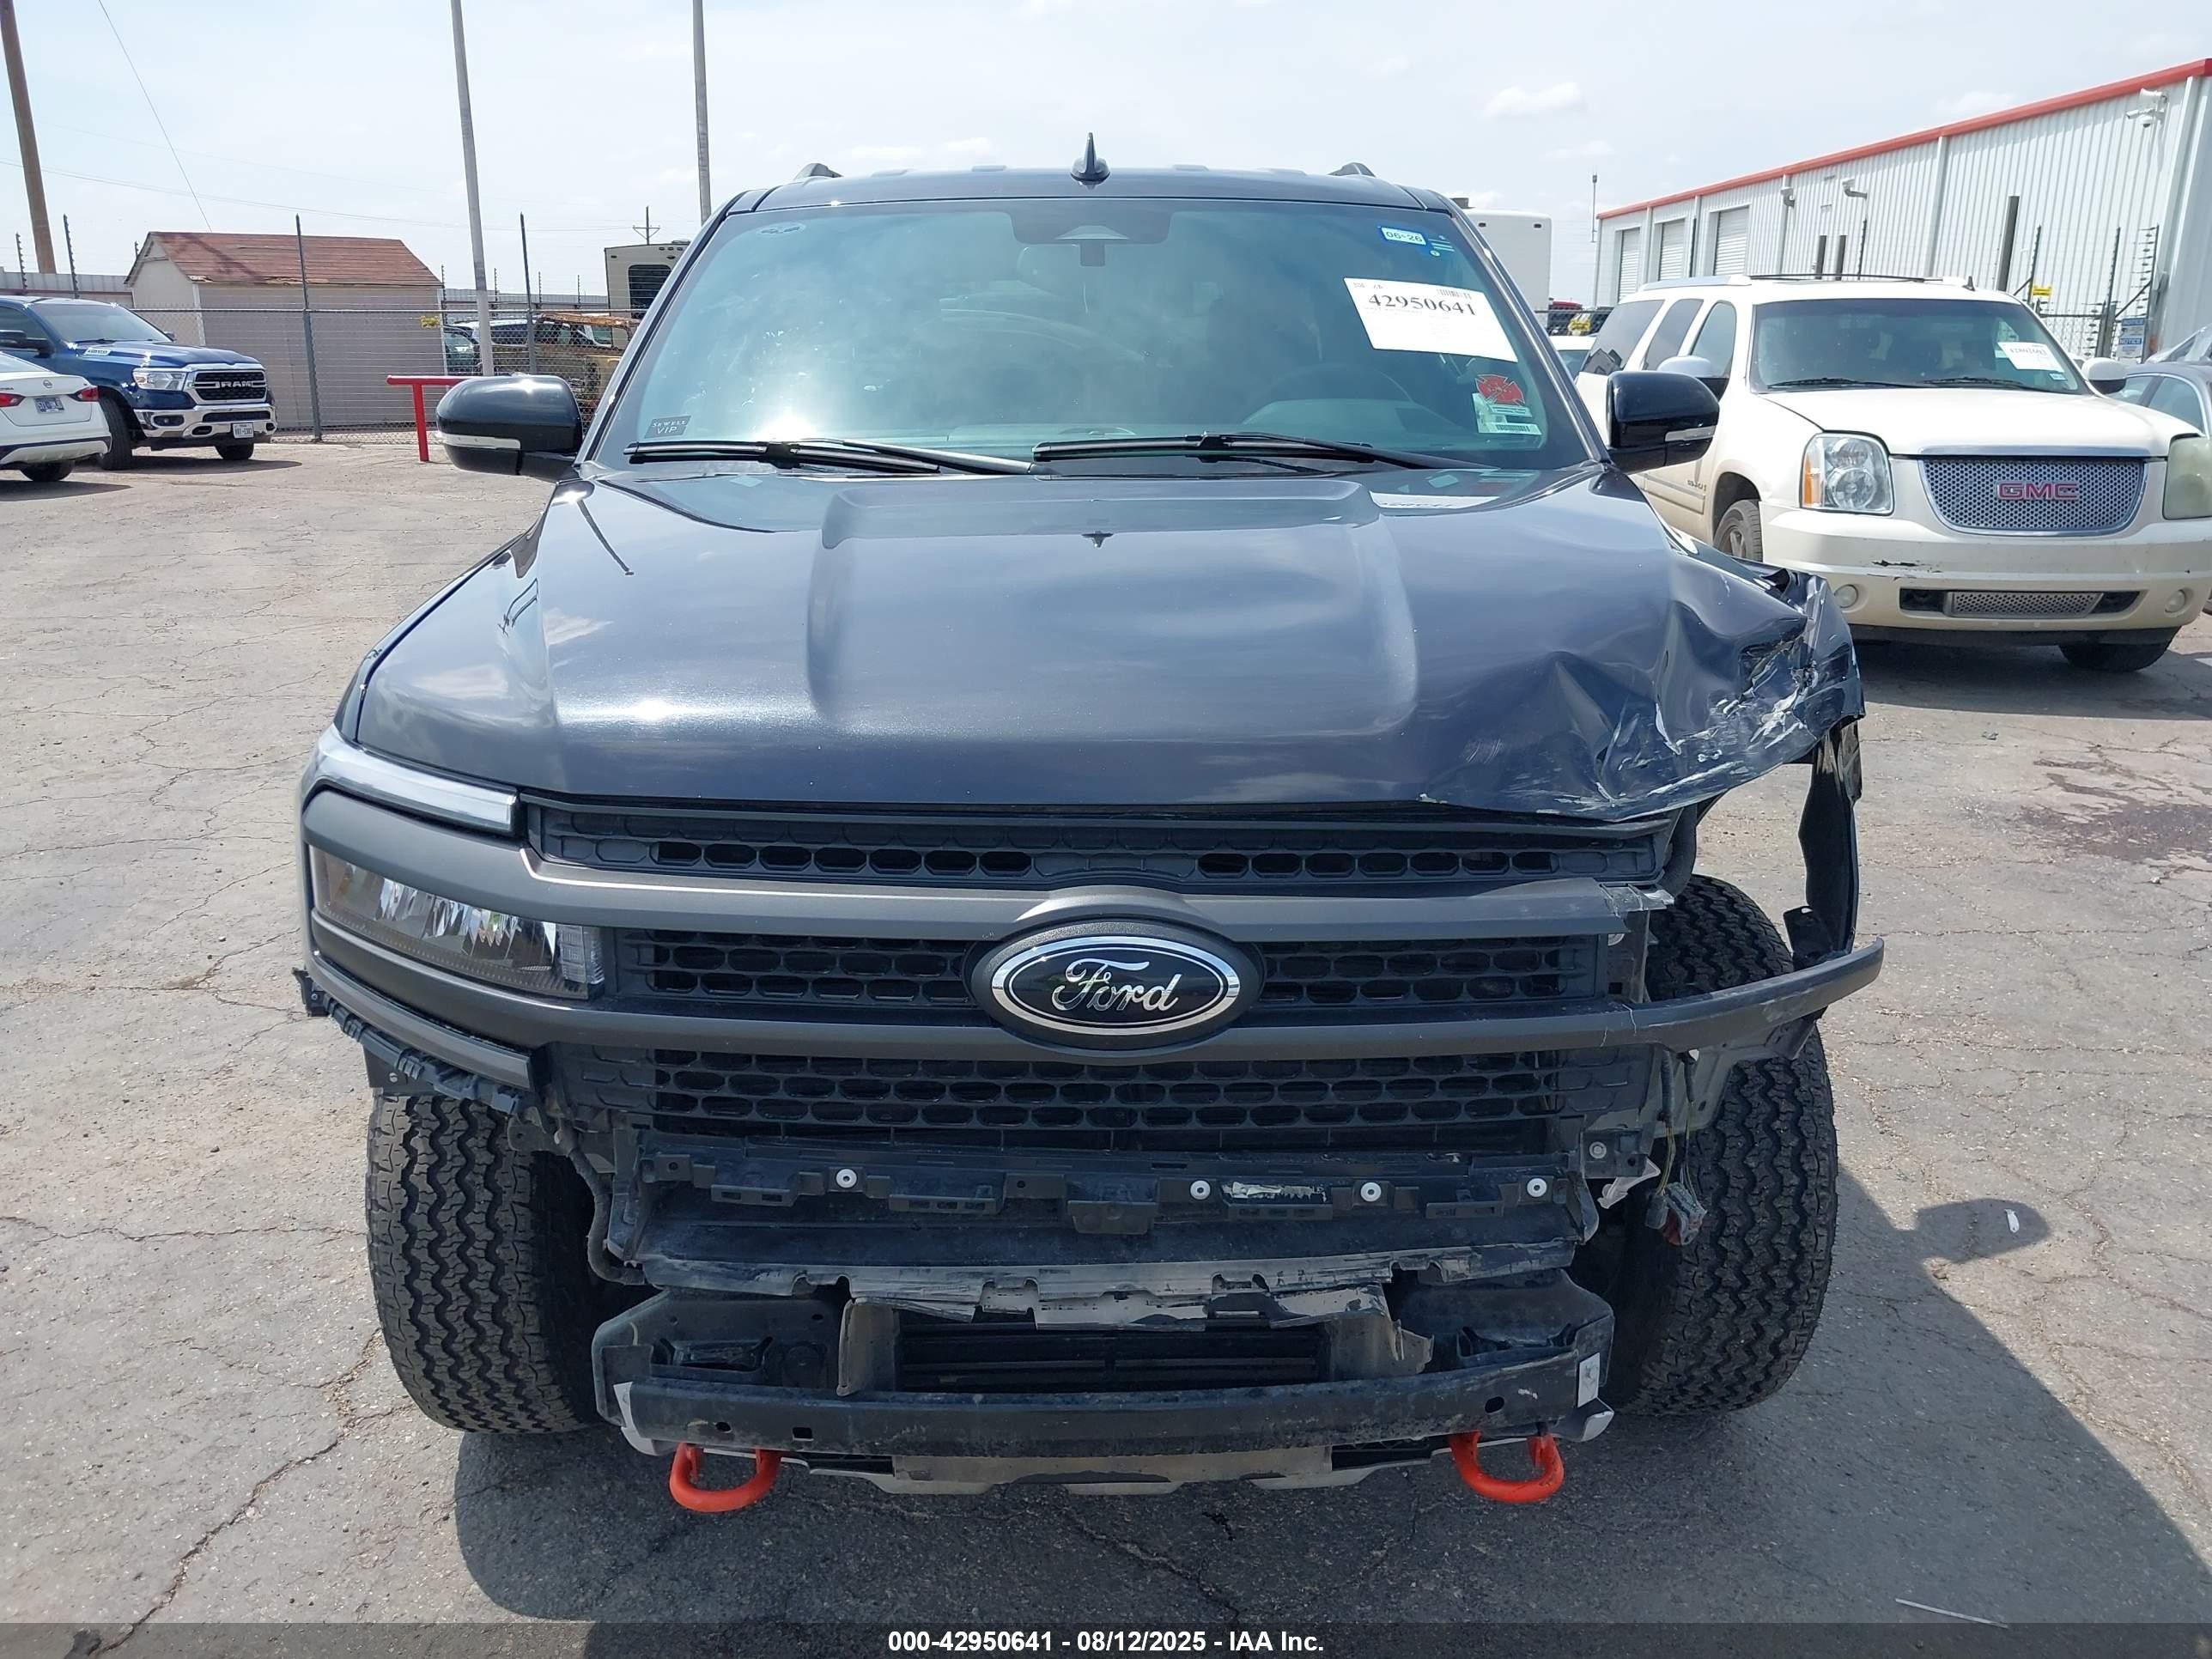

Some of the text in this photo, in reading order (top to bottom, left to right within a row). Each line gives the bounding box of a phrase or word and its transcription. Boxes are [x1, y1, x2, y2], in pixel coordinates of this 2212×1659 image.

[1368, 294, 1476, 316] 42950641
[657, 426, 678, 434] VIP
[1997, 482, 2078, 500] GMC
[1051, 957, 1182, 1012] Ford
